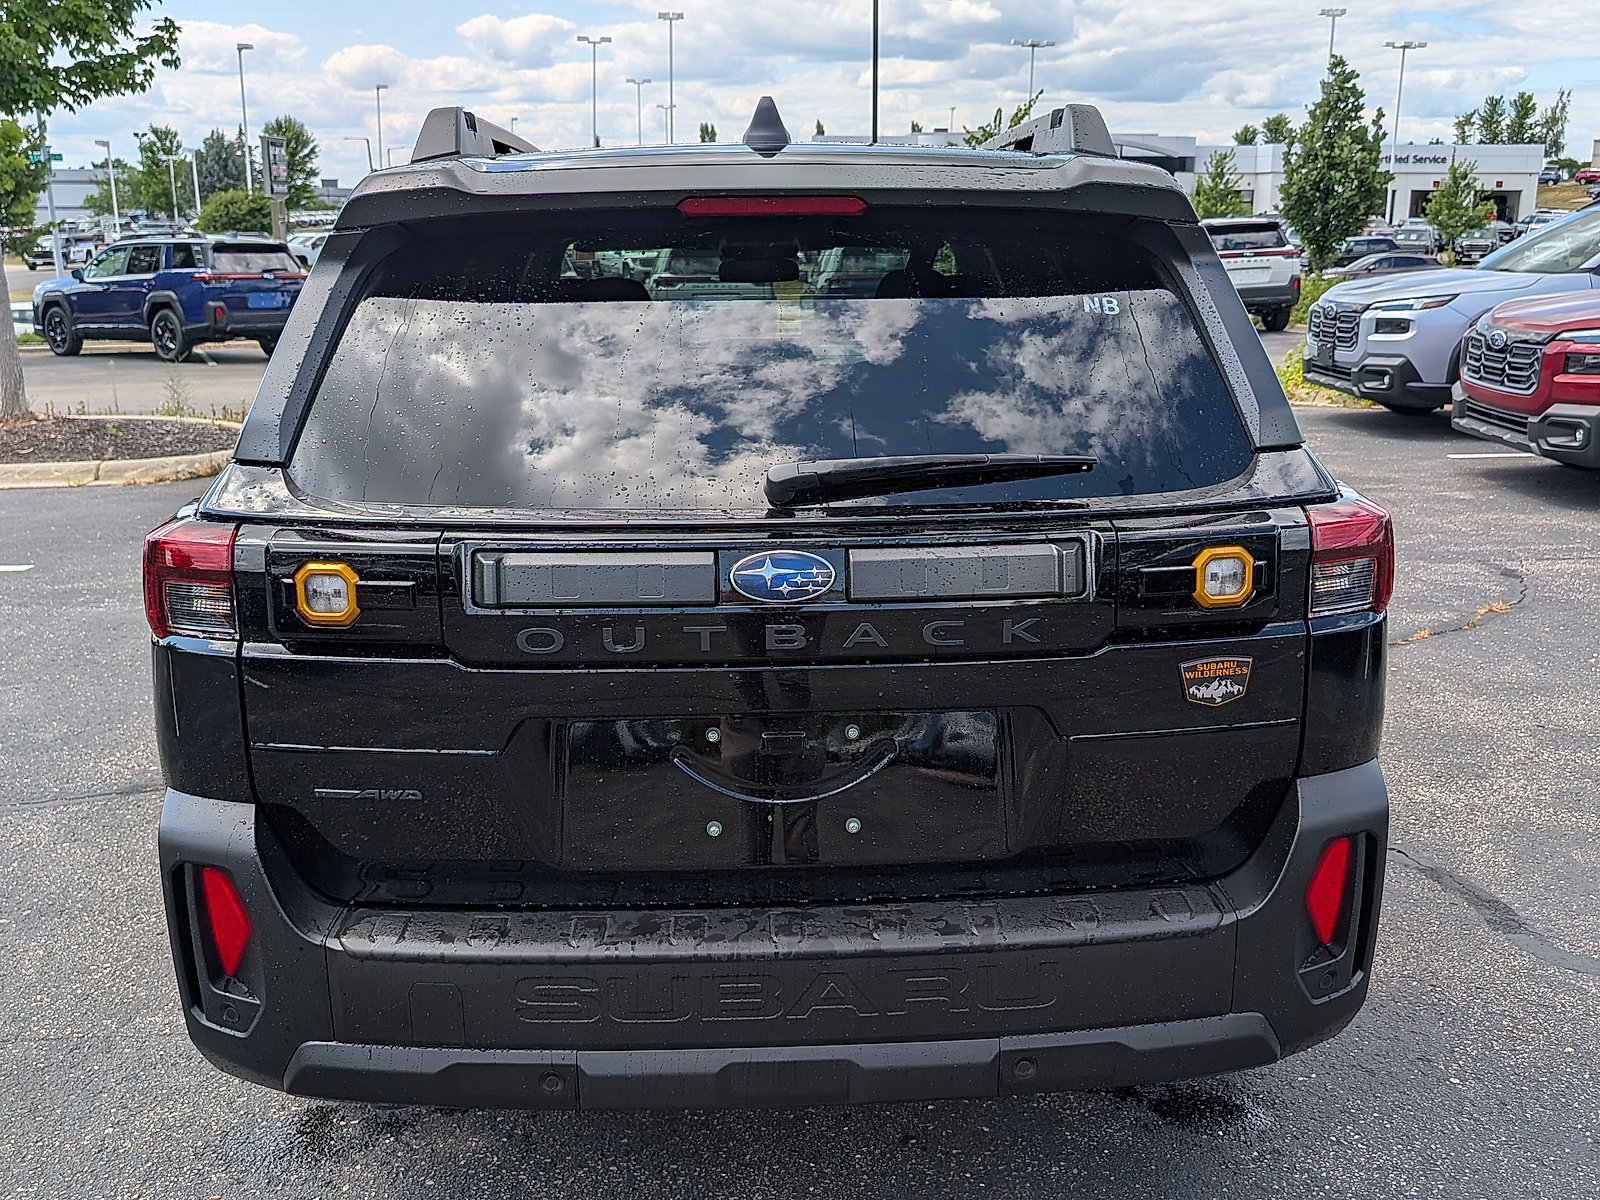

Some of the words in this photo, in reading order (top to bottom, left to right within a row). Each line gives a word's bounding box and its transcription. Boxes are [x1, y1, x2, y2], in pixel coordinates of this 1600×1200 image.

[1380, 155, 1409, 163] rtiied
[1413, 155, 1446, 163] Service
[1083, 296, 1120, 315] NB
[515, 618, 1042, 655] OUTBACK
[1196, 661, 1238, 671] SUBARU
[1185, 667, 1248, 678] WILDERNESS
[354, 789, 423, 800] AWD
[514, 961, 1058, 1023] SUBARU
